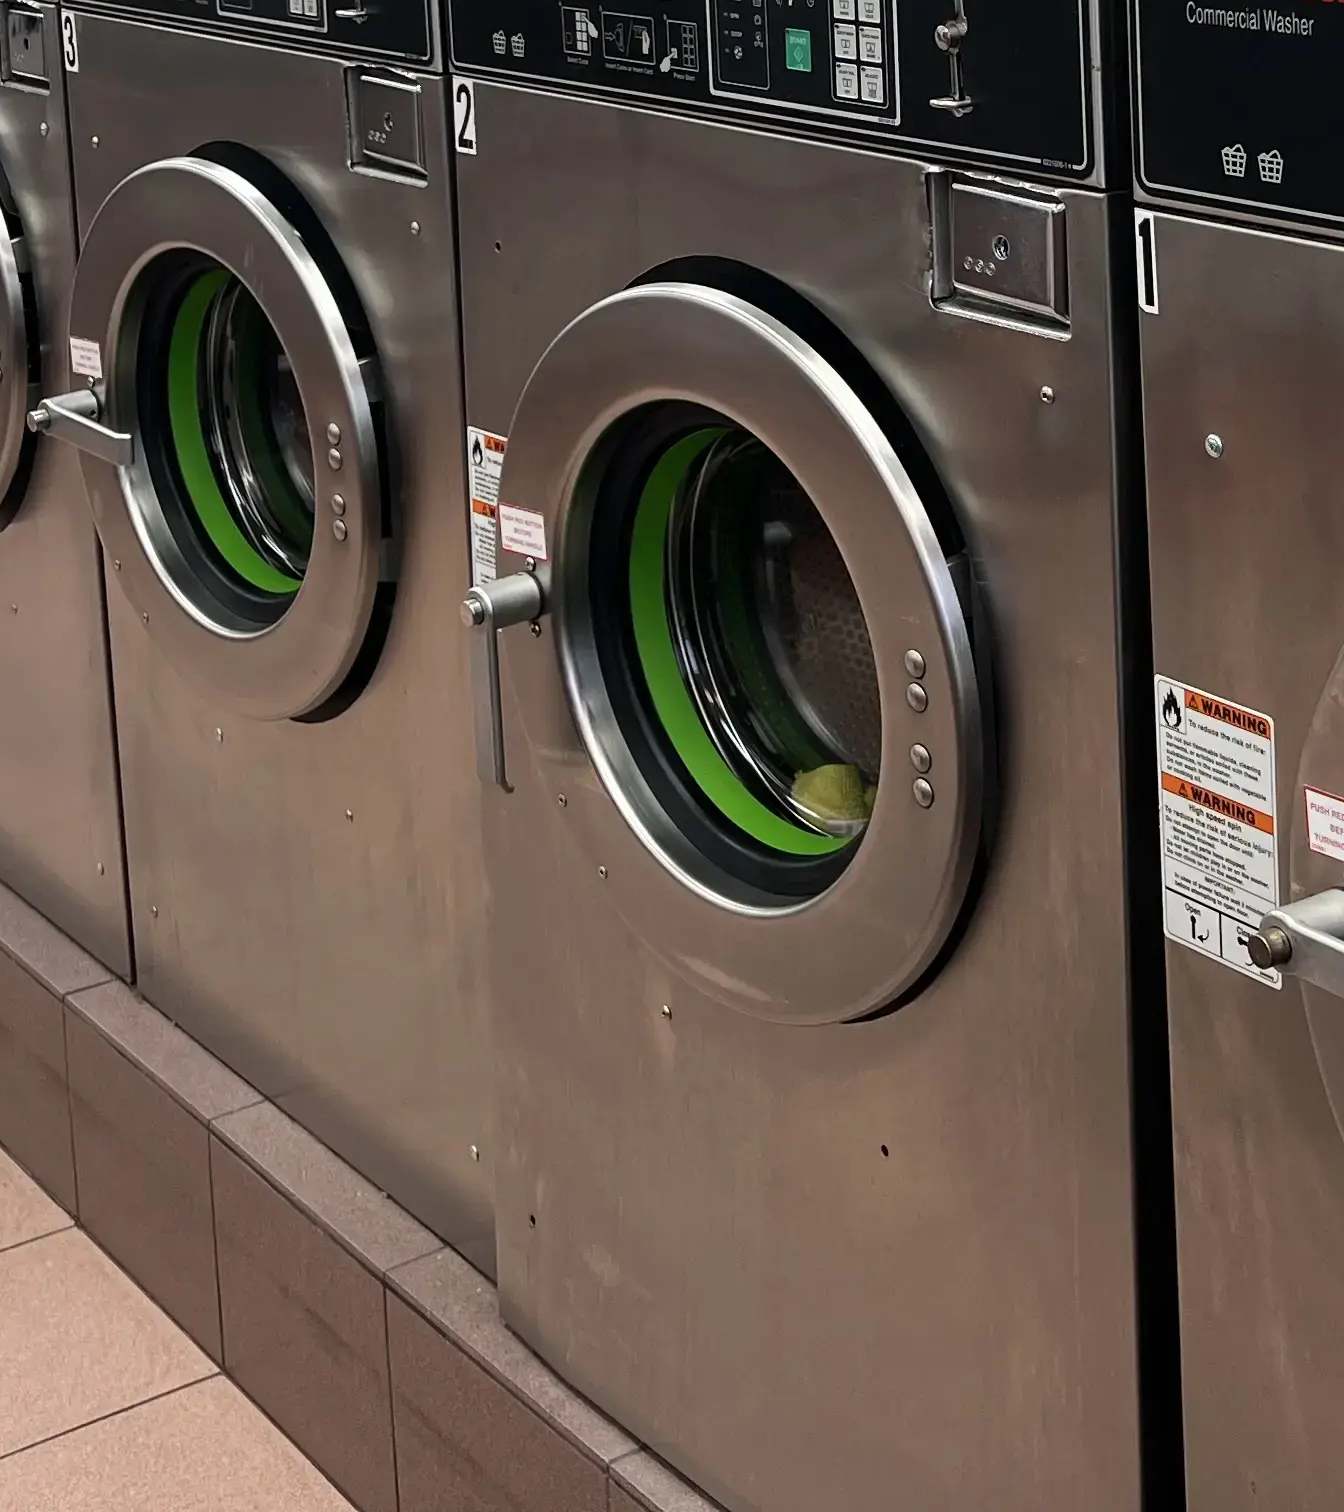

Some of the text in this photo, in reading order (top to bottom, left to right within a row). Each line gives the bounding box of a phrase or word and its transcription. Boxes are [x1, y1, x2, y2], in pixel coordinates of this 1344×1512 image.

[1186, 1, 1314, 36] Commercial Washer
[64, 16, 76, 67] 3
[456, 83, 474, 149] 2
[1138, 217, 1155, 307] 1
[1201, 698, 1267, 736] WARNING
[1188, 718, 1265, 755] To reduce the risk of fire:
[1188, 803, 1241, 833] High speed spin
[1191, 786, 1255, 825] WARNING
[1310, 802, 1330, 817] PUSH
[1184, 901, 1200, 917] Open
